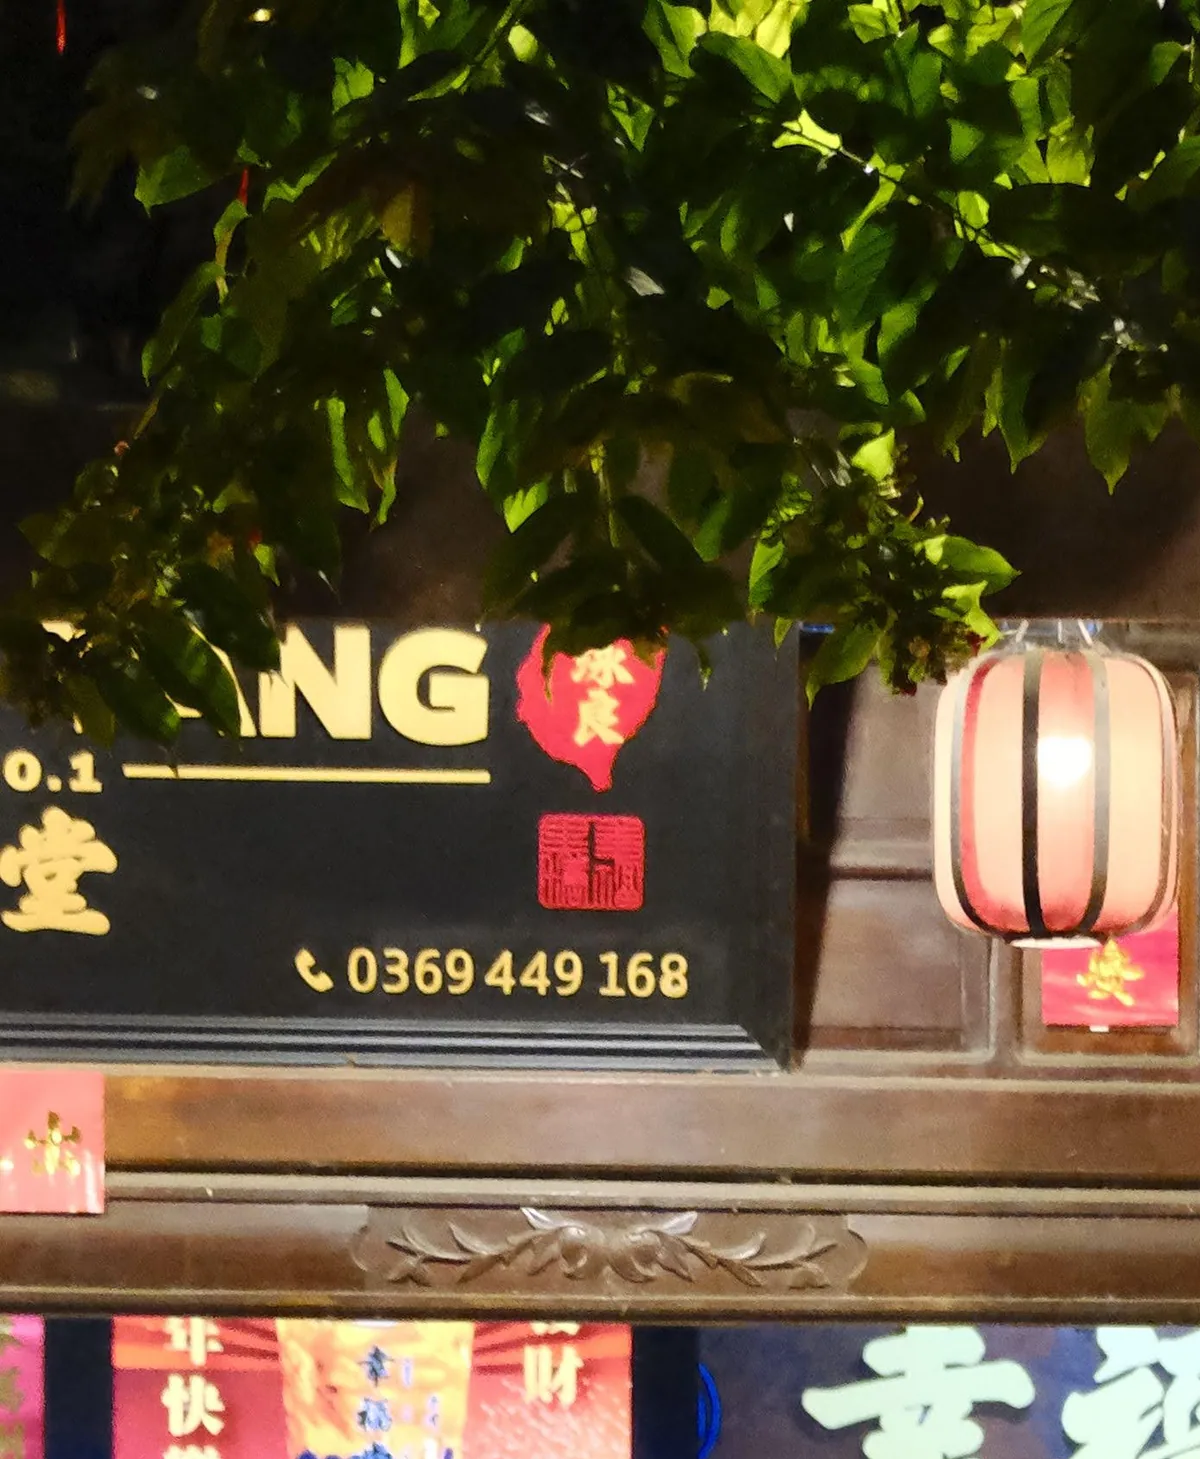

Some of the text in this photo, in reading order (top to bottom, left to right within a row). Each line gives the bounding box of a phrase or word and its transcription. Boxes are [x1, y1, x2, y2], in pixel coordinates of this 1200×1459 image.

[0, 806, 118, 936] 堂
[347, 947, 689, 999] 0369 449 168
